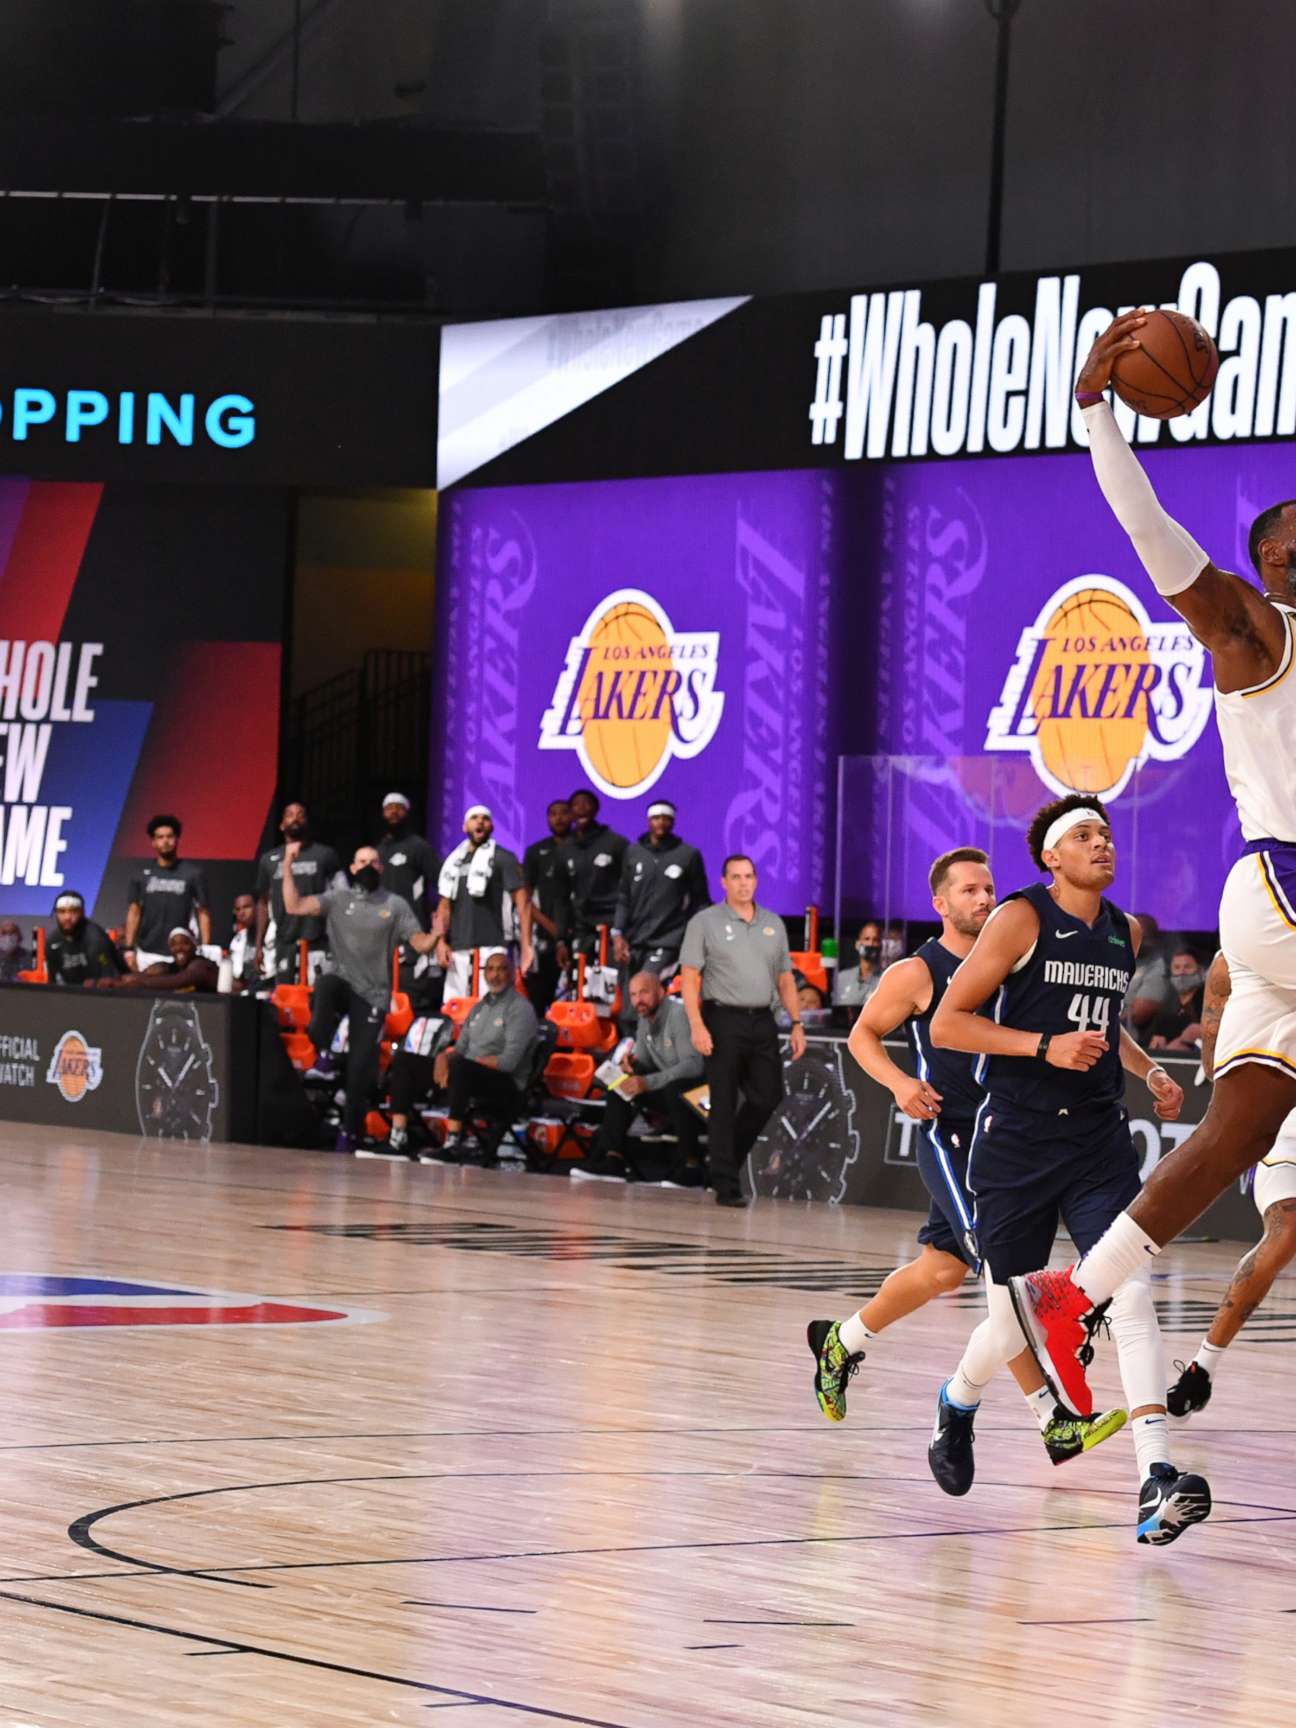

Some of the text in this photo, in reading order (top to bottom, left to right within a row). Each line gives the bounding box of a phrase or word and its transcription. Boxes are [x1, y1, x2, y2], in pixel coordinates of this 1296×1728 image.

[0, 388, 256, 448] PPING
[603, 643, 710, 660] LOS ANGELES
[1062, 634, 1195, 653] LOS ANGELES
[557, 646, 707, 744] LAKERS
[998, 637, 1193, 746] LAKERS
[0, 805, 73, 887] ME
[1067, 993, 1111, 1038] 44
[0, 1035, 40, 1061] FICIAL
